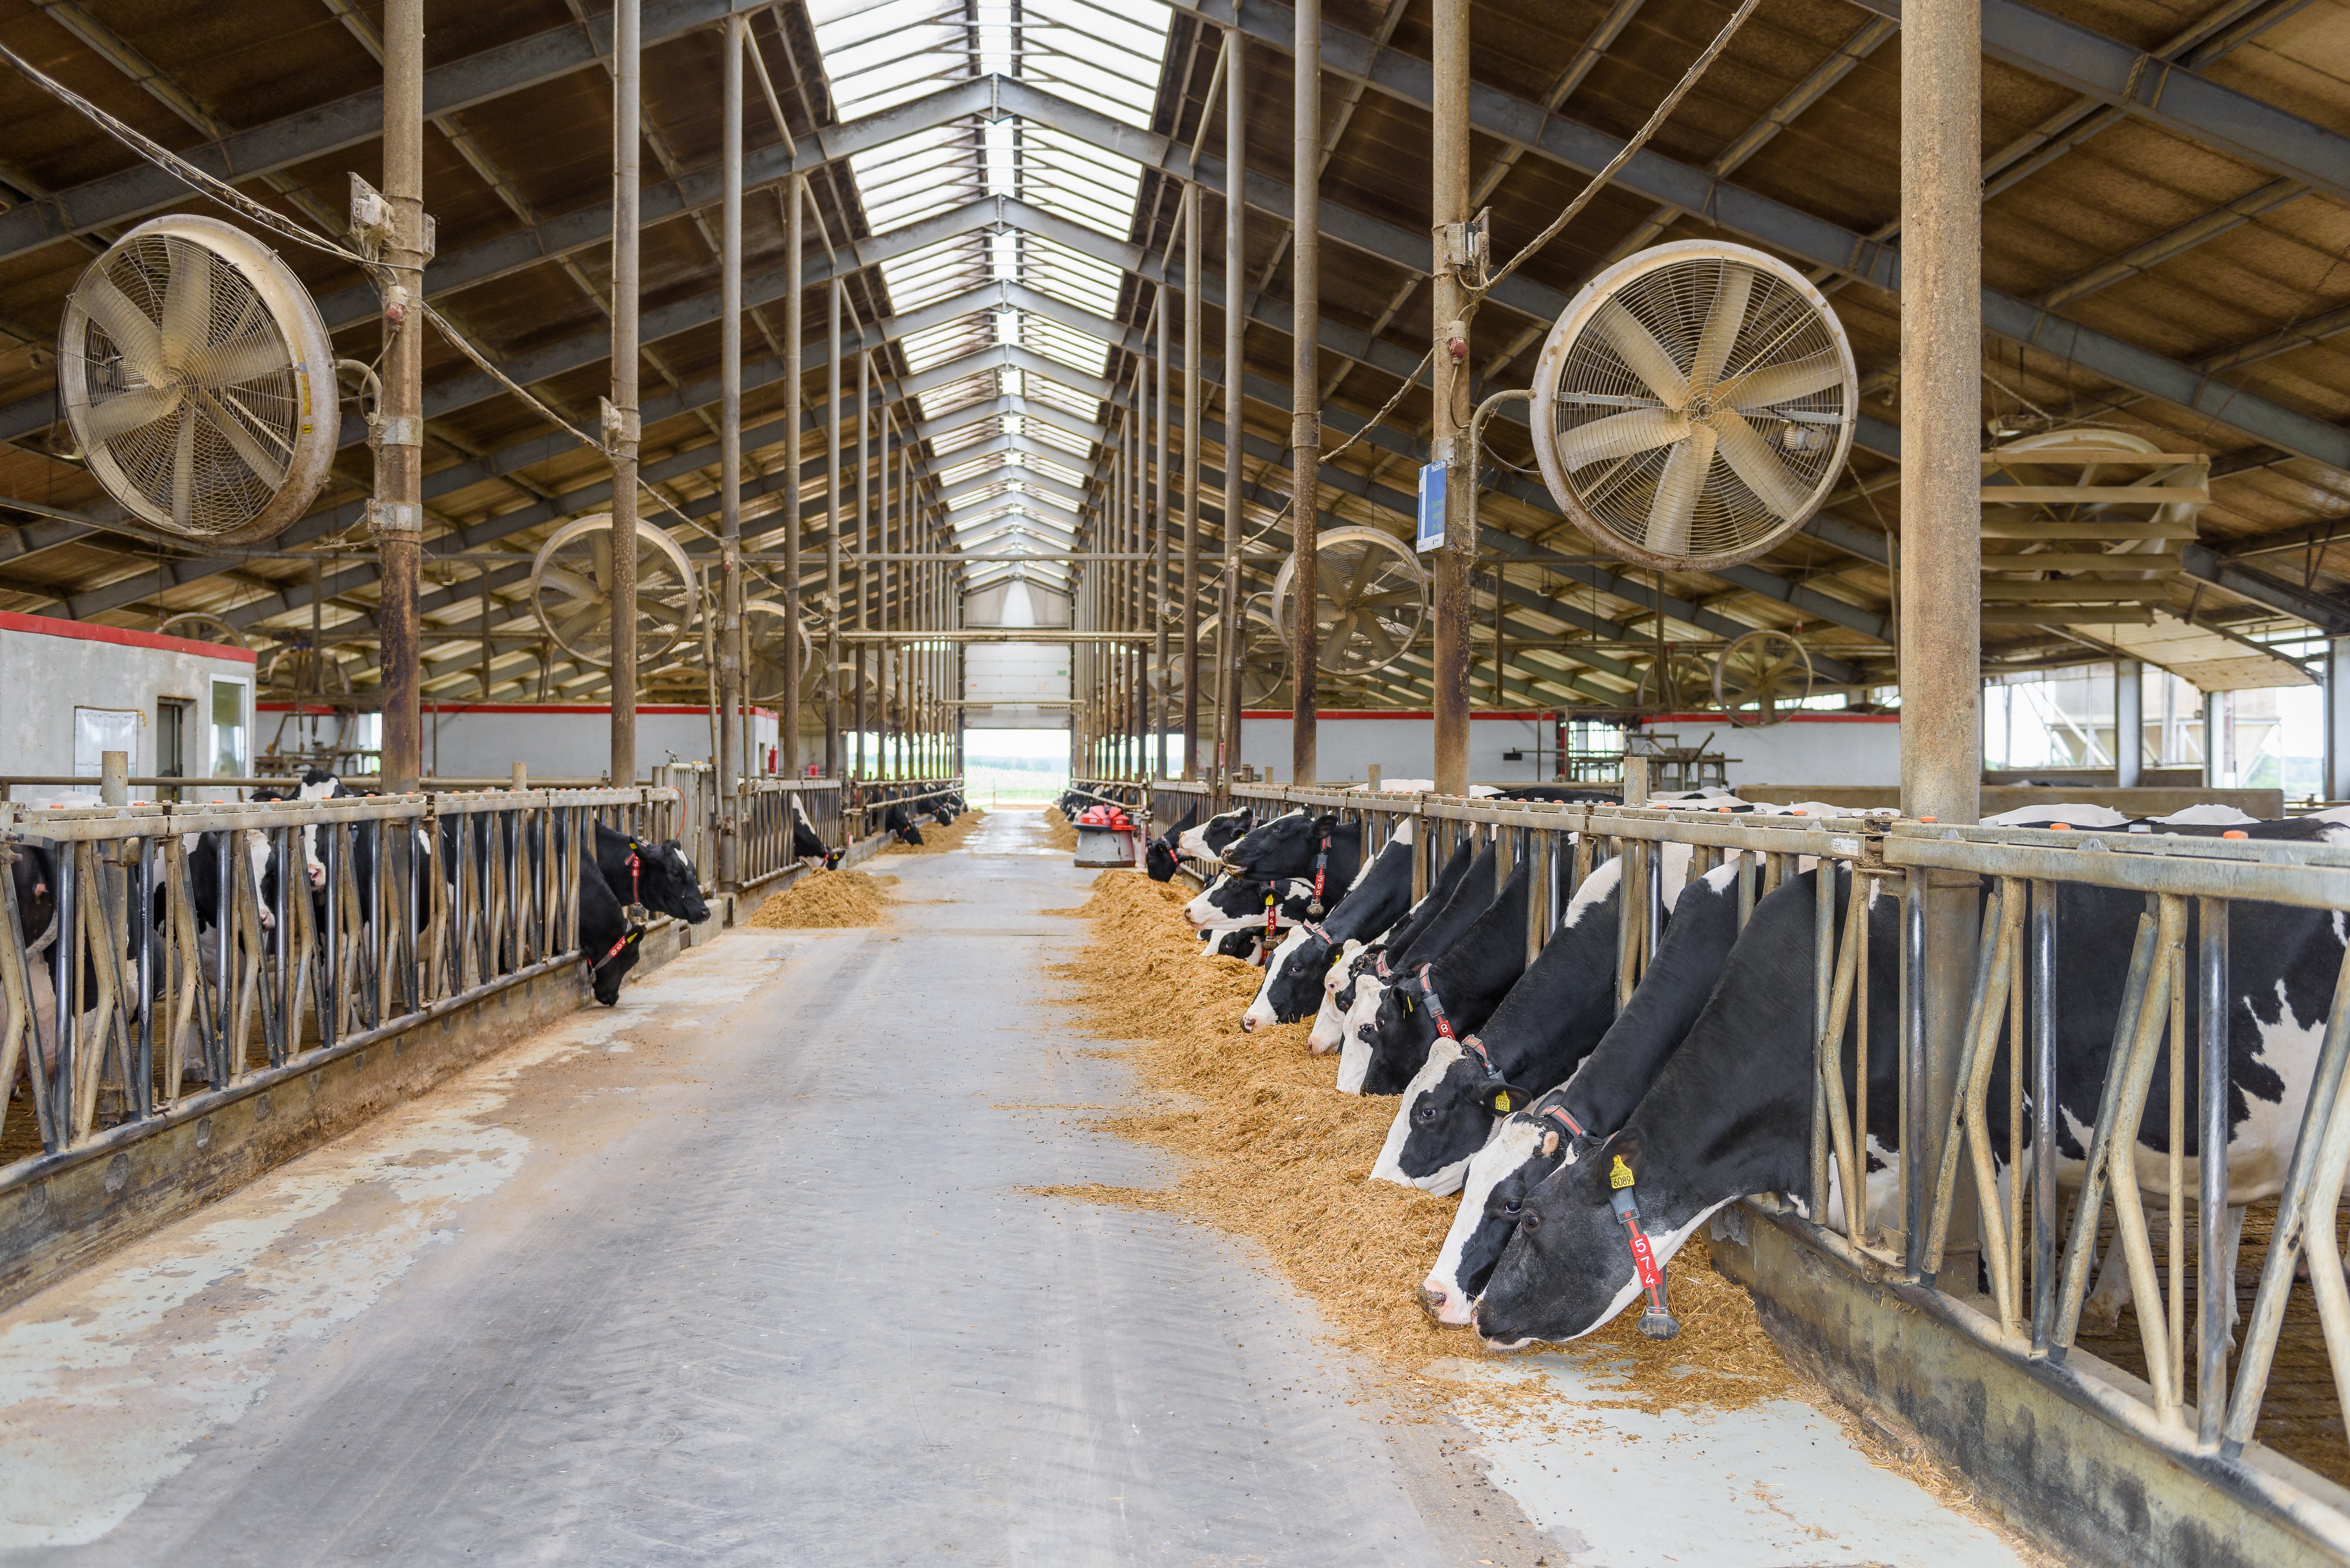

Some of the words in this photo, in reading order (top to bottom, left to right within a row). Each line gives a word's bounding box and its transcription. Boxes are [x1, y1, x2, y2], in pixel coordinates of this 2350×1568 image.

[1496, 1101, 1508, 1110] 6125
[1614, 1175, 1631, 1187] 6089
[1634, 1238, 1655, 1284] 574
